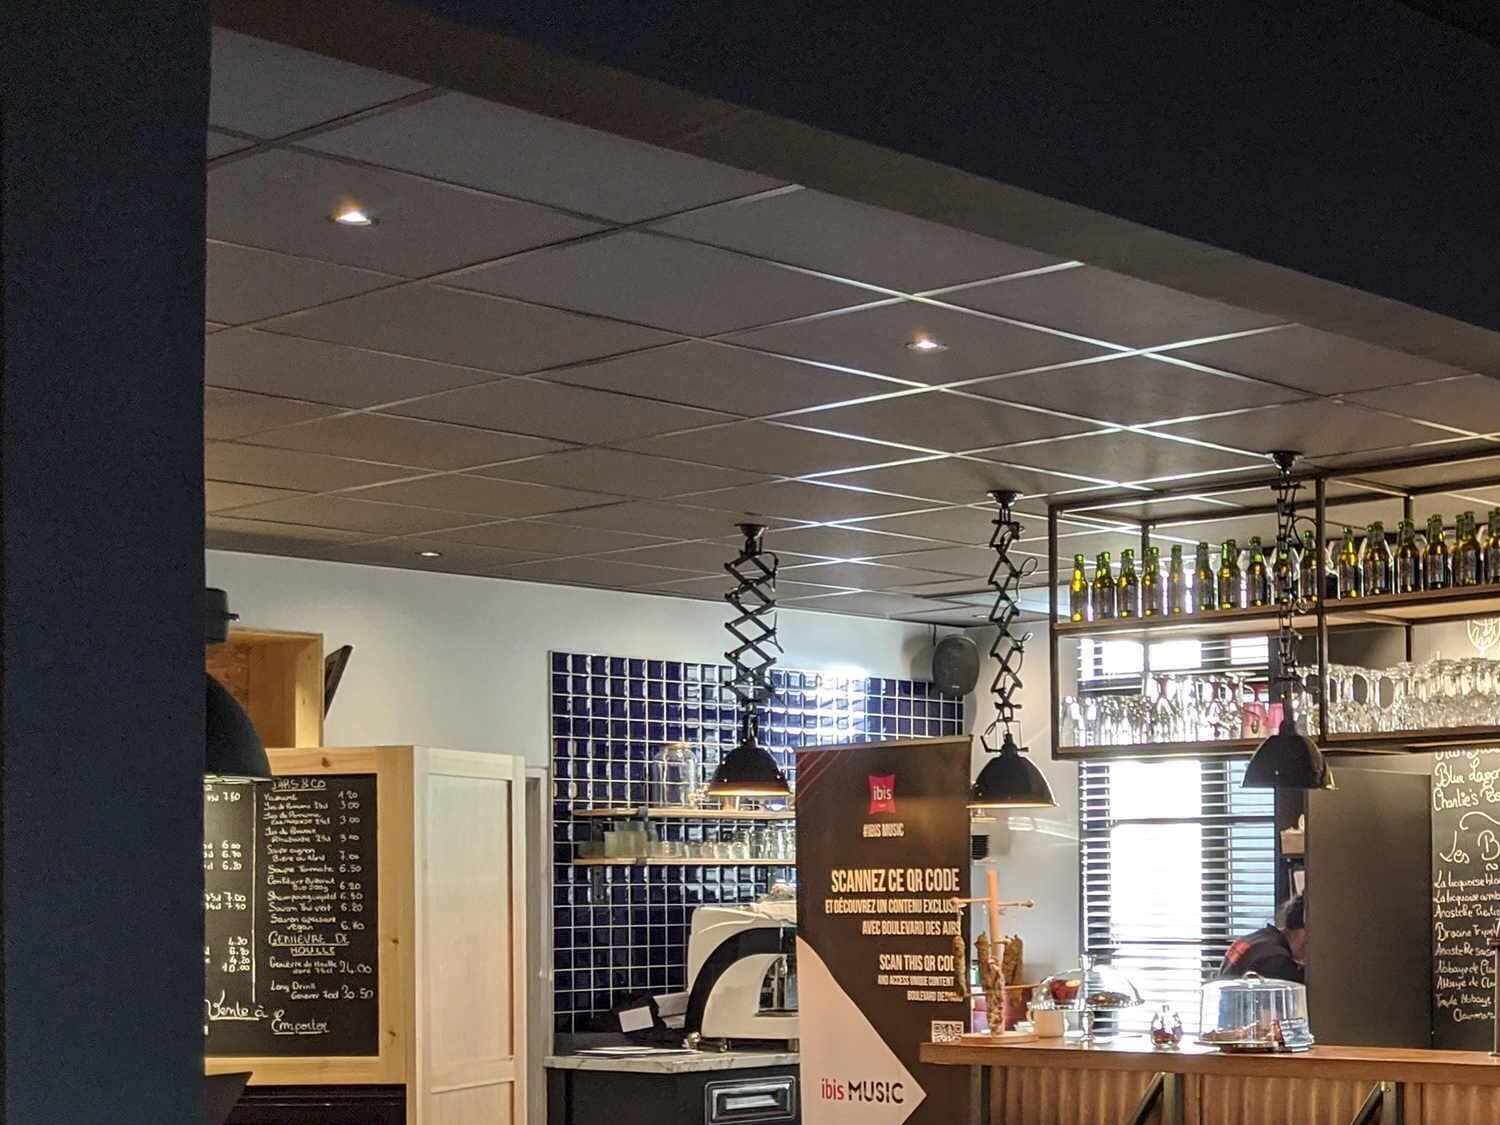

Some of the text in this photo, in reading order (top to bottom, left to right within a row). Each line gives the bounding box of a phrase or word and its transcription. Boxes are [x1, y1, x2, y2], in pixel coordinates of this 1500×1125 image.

[1434, 762, 1464, 787] Blue
[873, 785, 893, 800] ibis
[882, 823, 904, 837] MUSIC
[831, 868, 960, 893] SCANNEZ CE QR CODE
[825, 900, 833, 914] ET
[834, 897, 877, 914] DÉCOUVREZ
[877, 900, 888, 914] UN
[889, 899, 923, 914] CONTENU
[862, 921, 880, 935] AVEC
[882, 920, 924, 935] BOULEVARD
[925, 920, 941, 935] DES
[880, 954, 902, 970] SCAN
[904, 955, 923, 970] THIS
[924, 955, 936, 970] QR
[822, 1079, 904, 1104] ibis MUSIC
